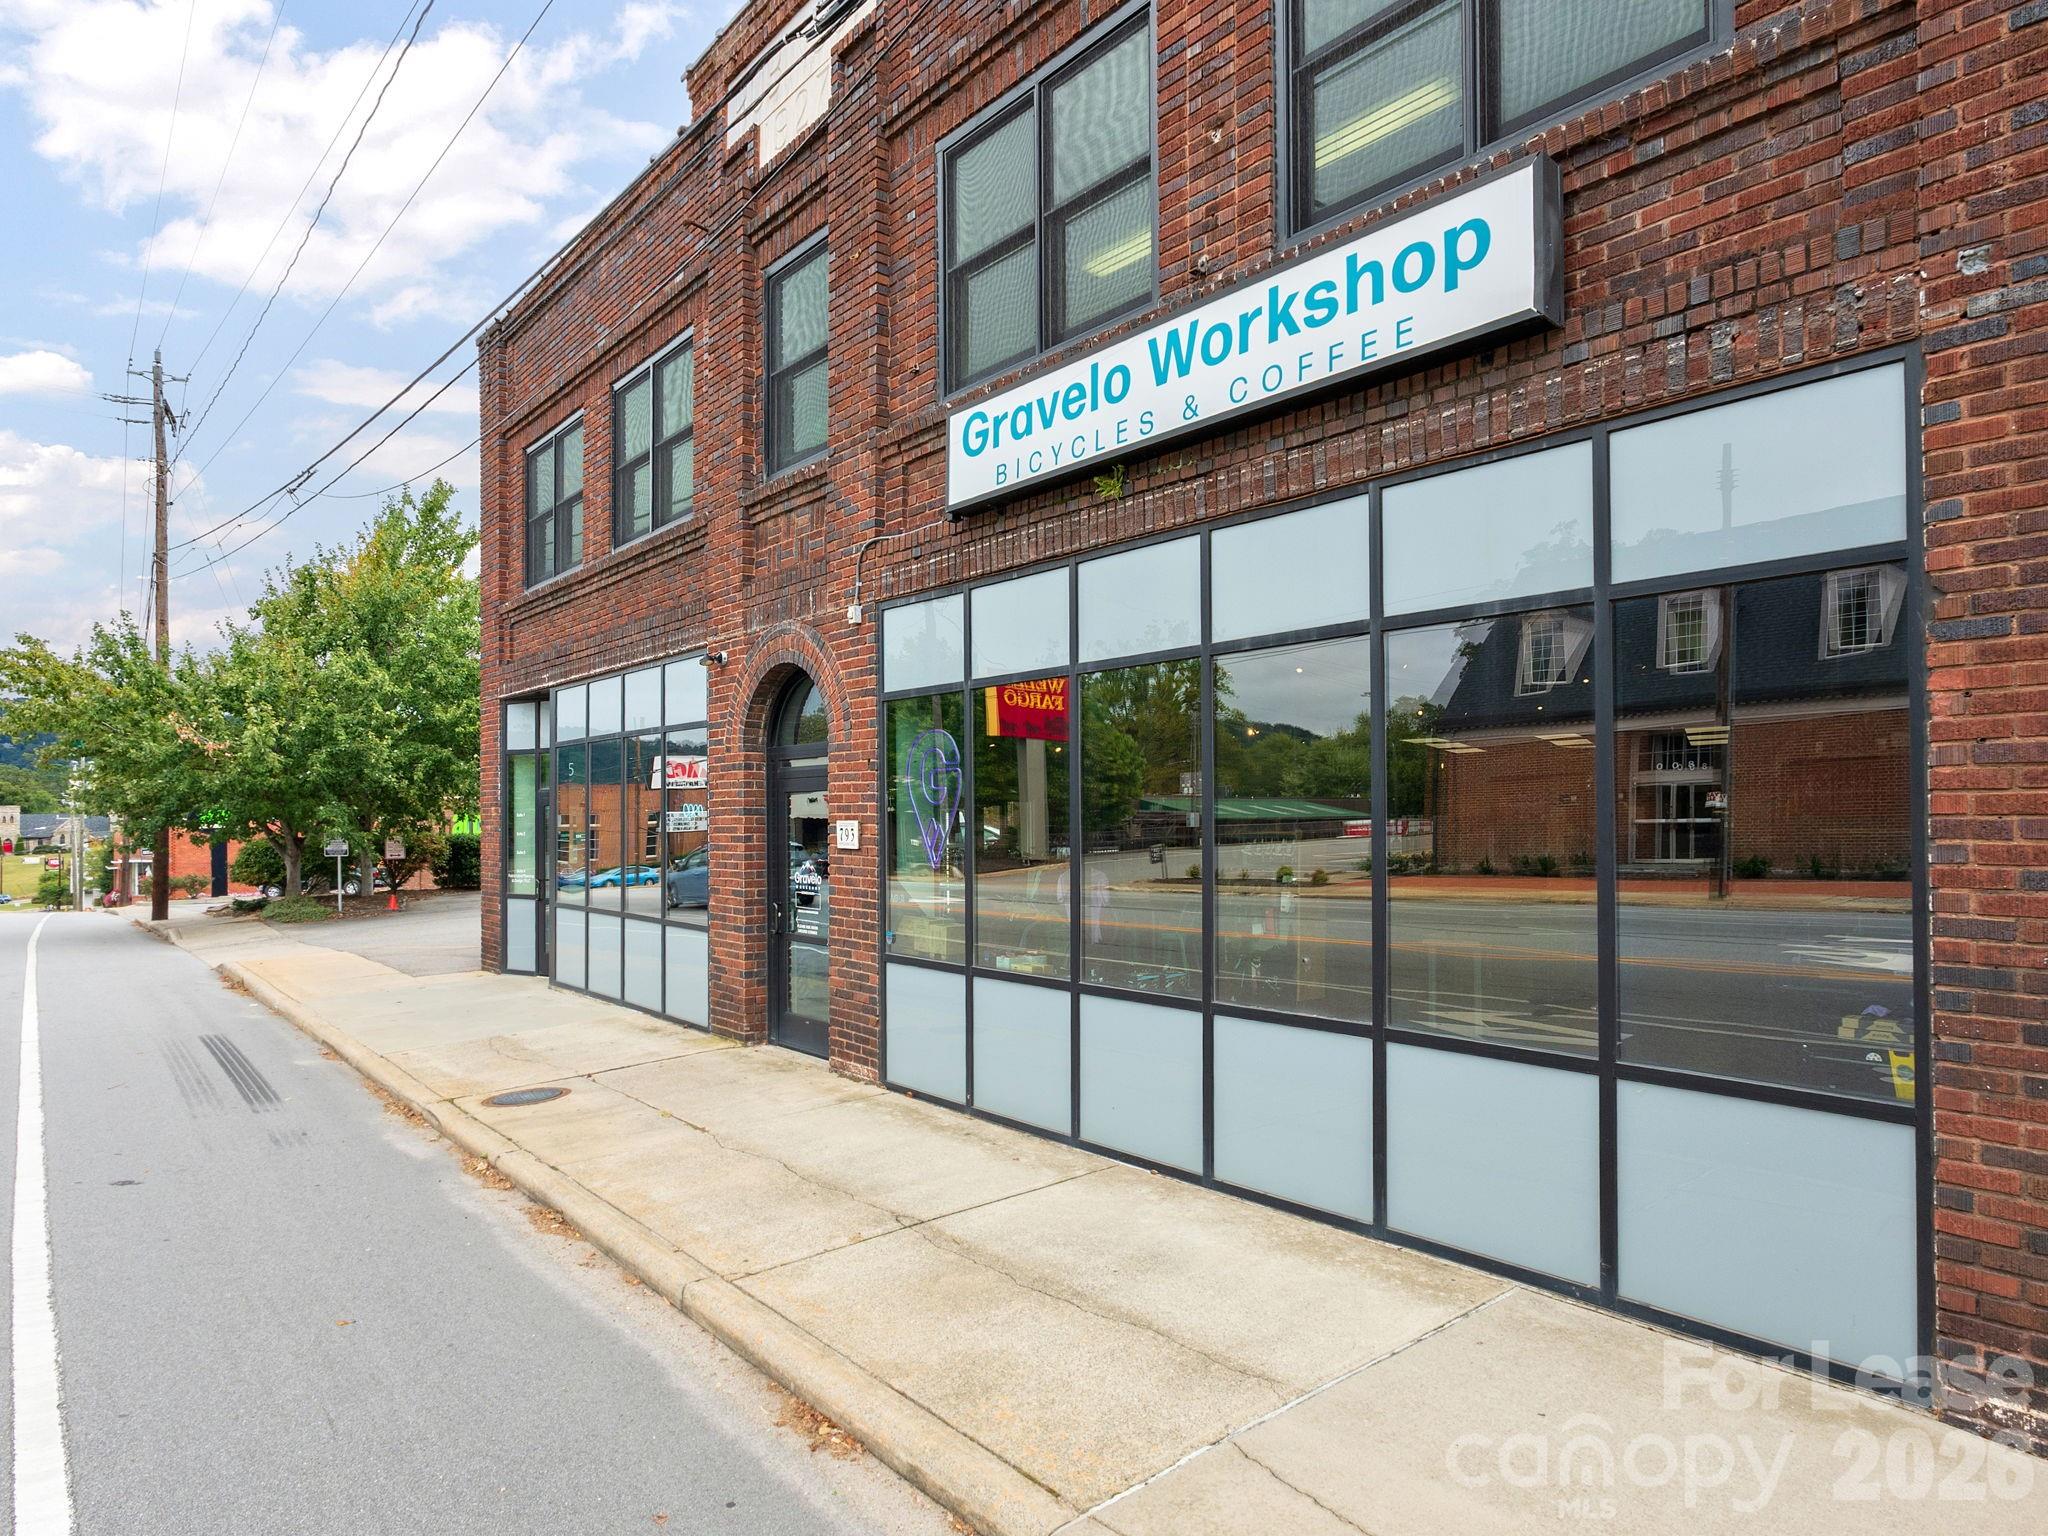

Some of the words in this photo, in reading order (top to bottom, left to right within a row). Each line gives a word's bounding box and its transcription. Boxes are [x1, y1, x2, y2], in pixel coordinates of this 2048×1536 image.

[961, 363, 1132, 458] Gravelo
[1147, 217, 1492, 387] Workshop
[996, 411, 1154, 486] BICYCLES
[1182, 395, 1200, 421] &
[1229, 316, 1414, 405] COFFEE
[568, 762, 575, 777] 5
[839, 827, 855, 842] 795
[794, 871, 822, 885] Gravelo
